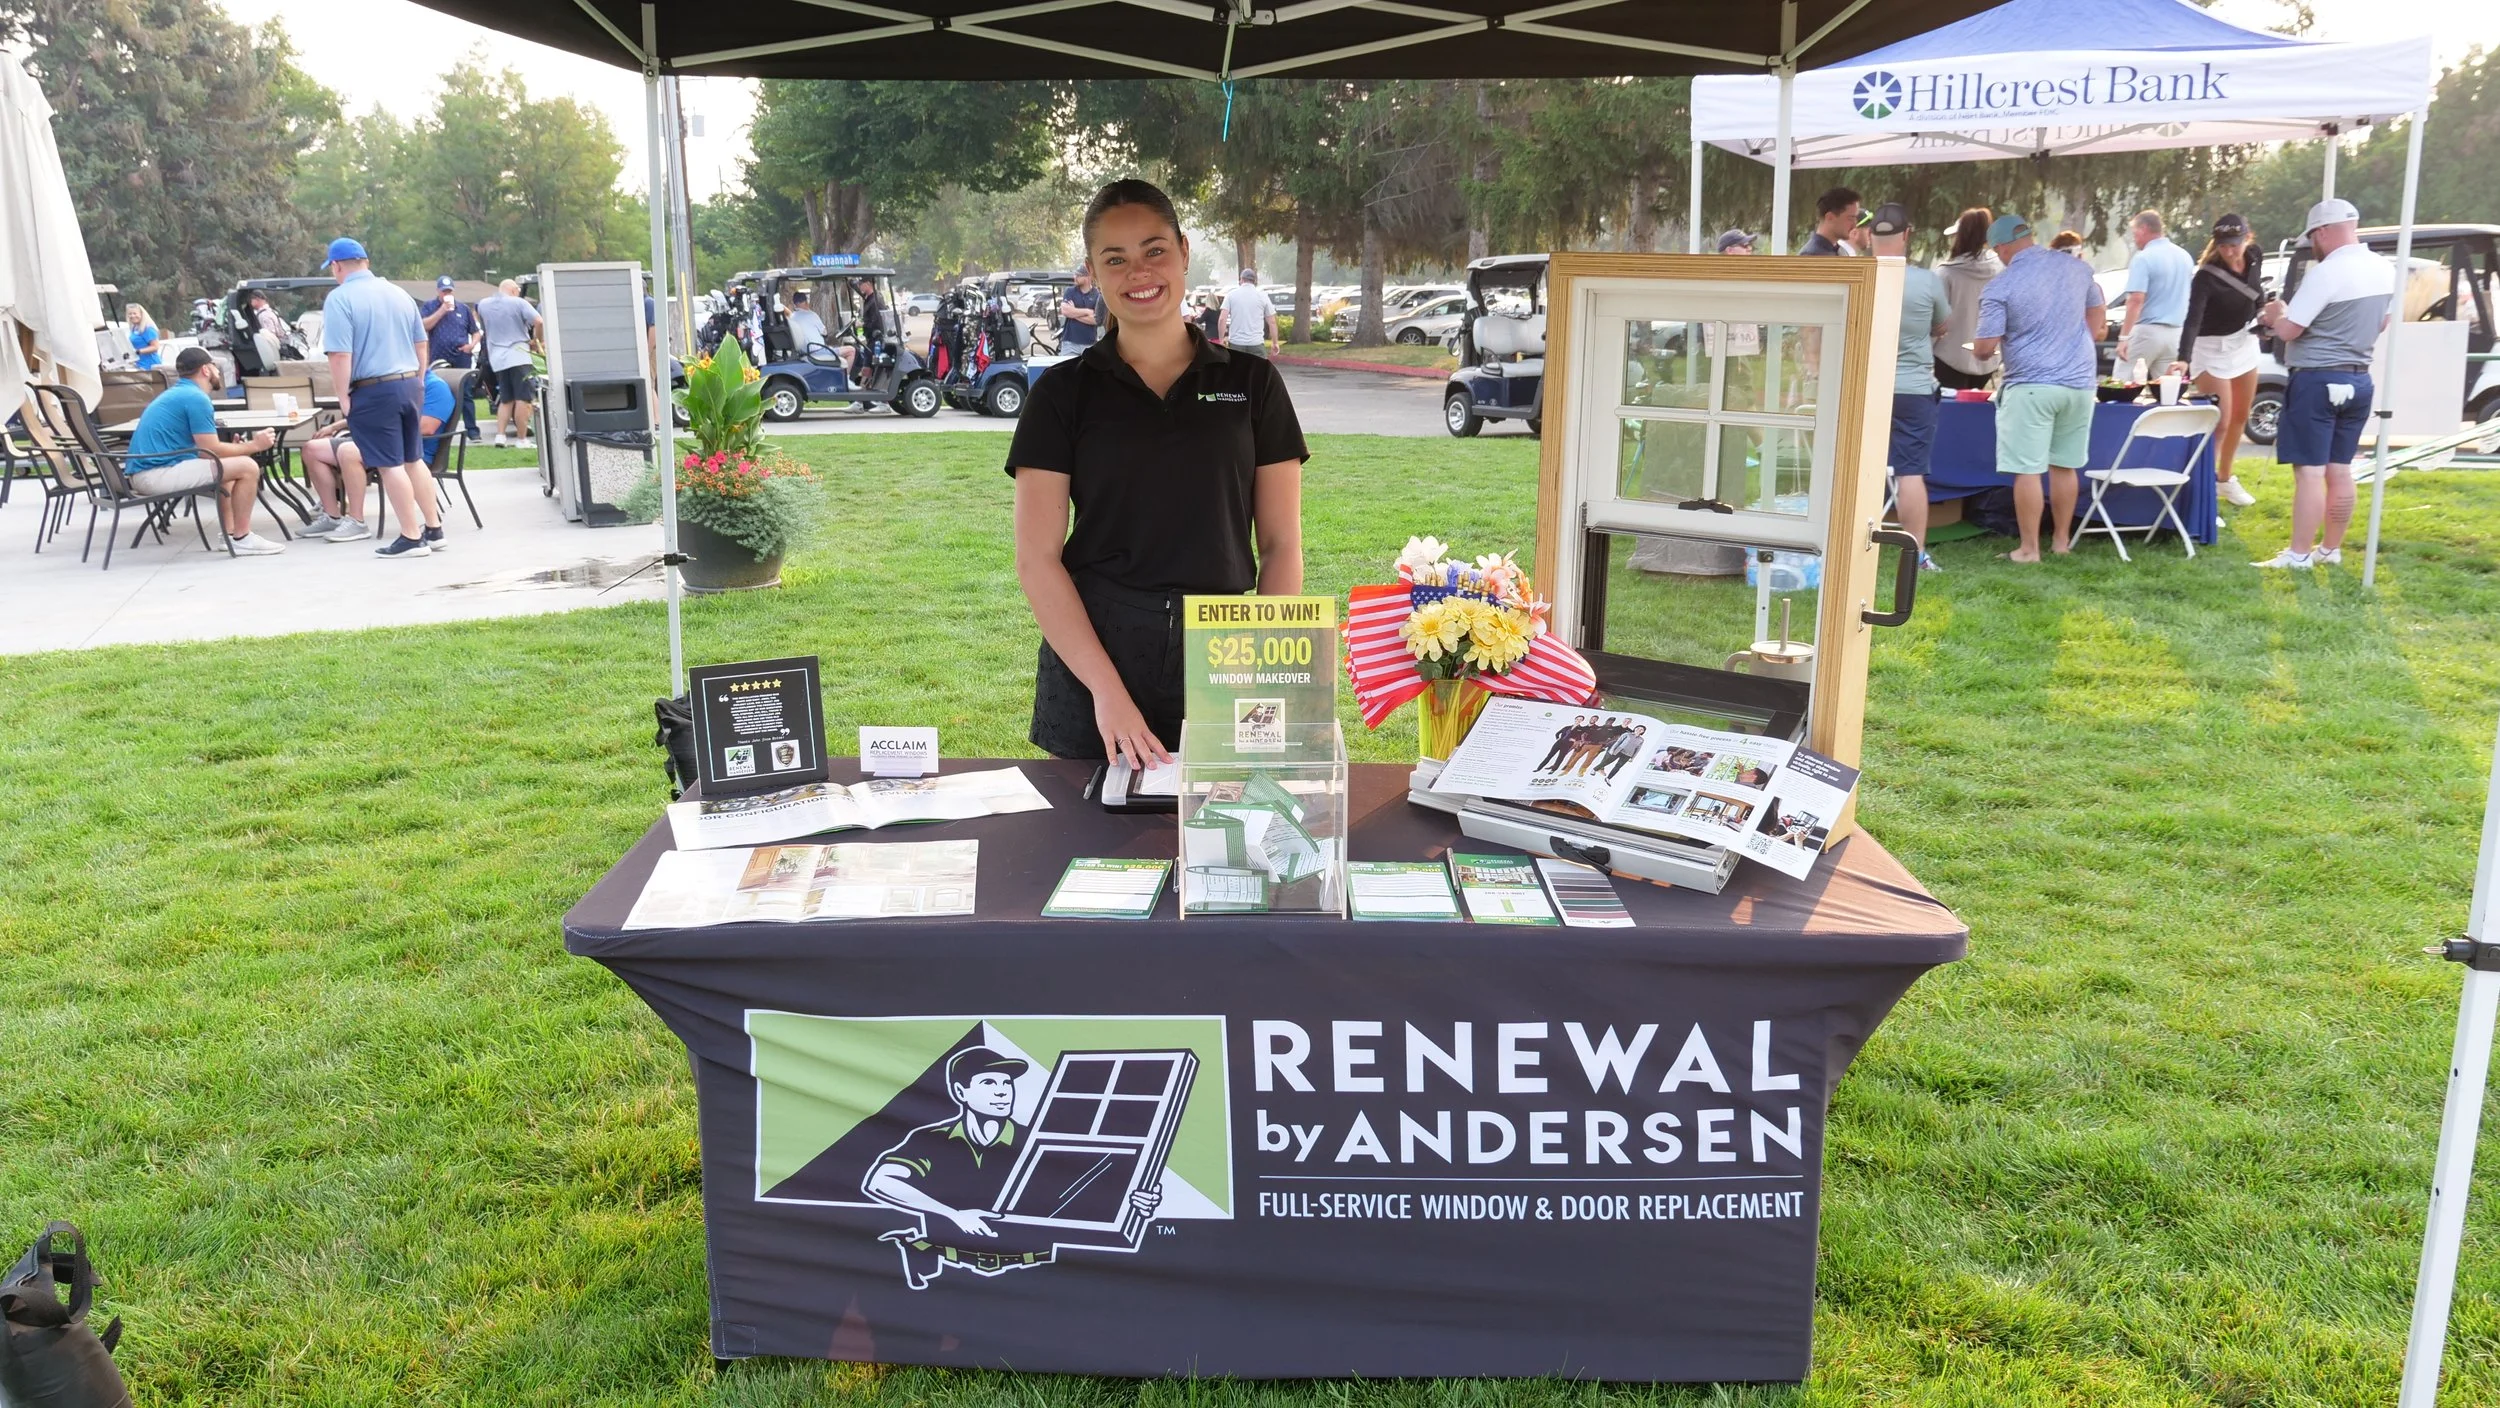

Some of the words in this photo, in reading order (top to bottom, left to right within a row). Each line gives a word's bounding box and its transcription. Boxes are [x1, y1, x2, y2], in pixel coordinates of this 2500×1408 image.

[1905, 67, 2098, 113] Hillcrest
[2104, 62, 2229, 104] Bank
[817, 255, 853, 266] Savannah
[1198, 604, 1250, 622] ENTER
[1255, 603, 1275, 622] TO
[1280, 603, 1320, 621] WIN!
[1207, 636, 1312, 671] $25,000
[1209, 673, 1253, 684] WINDOW
[1256, 672, 1311, 684] MAKEOVER
[870, 740, 927, 750] ACCLAIM
[1252, 1019, 1800, 1096] RENEWAL
[1257, 1109, 1324, 1162] by
[1334, 1107, 1803, 1165] ANDERSEN
[1259, 1192, 1412, 1219] FULL-SERVICE
[1421, 1194, 1528, 1220] WINDOW
[1535, 1197, 1554, 1220] &
[1562, 1194, 1630, 1221] DOOR
[1639, 1191, 1804, 1220] REPLACEMENT
[1157, 1225, 1176, 1236] TM
